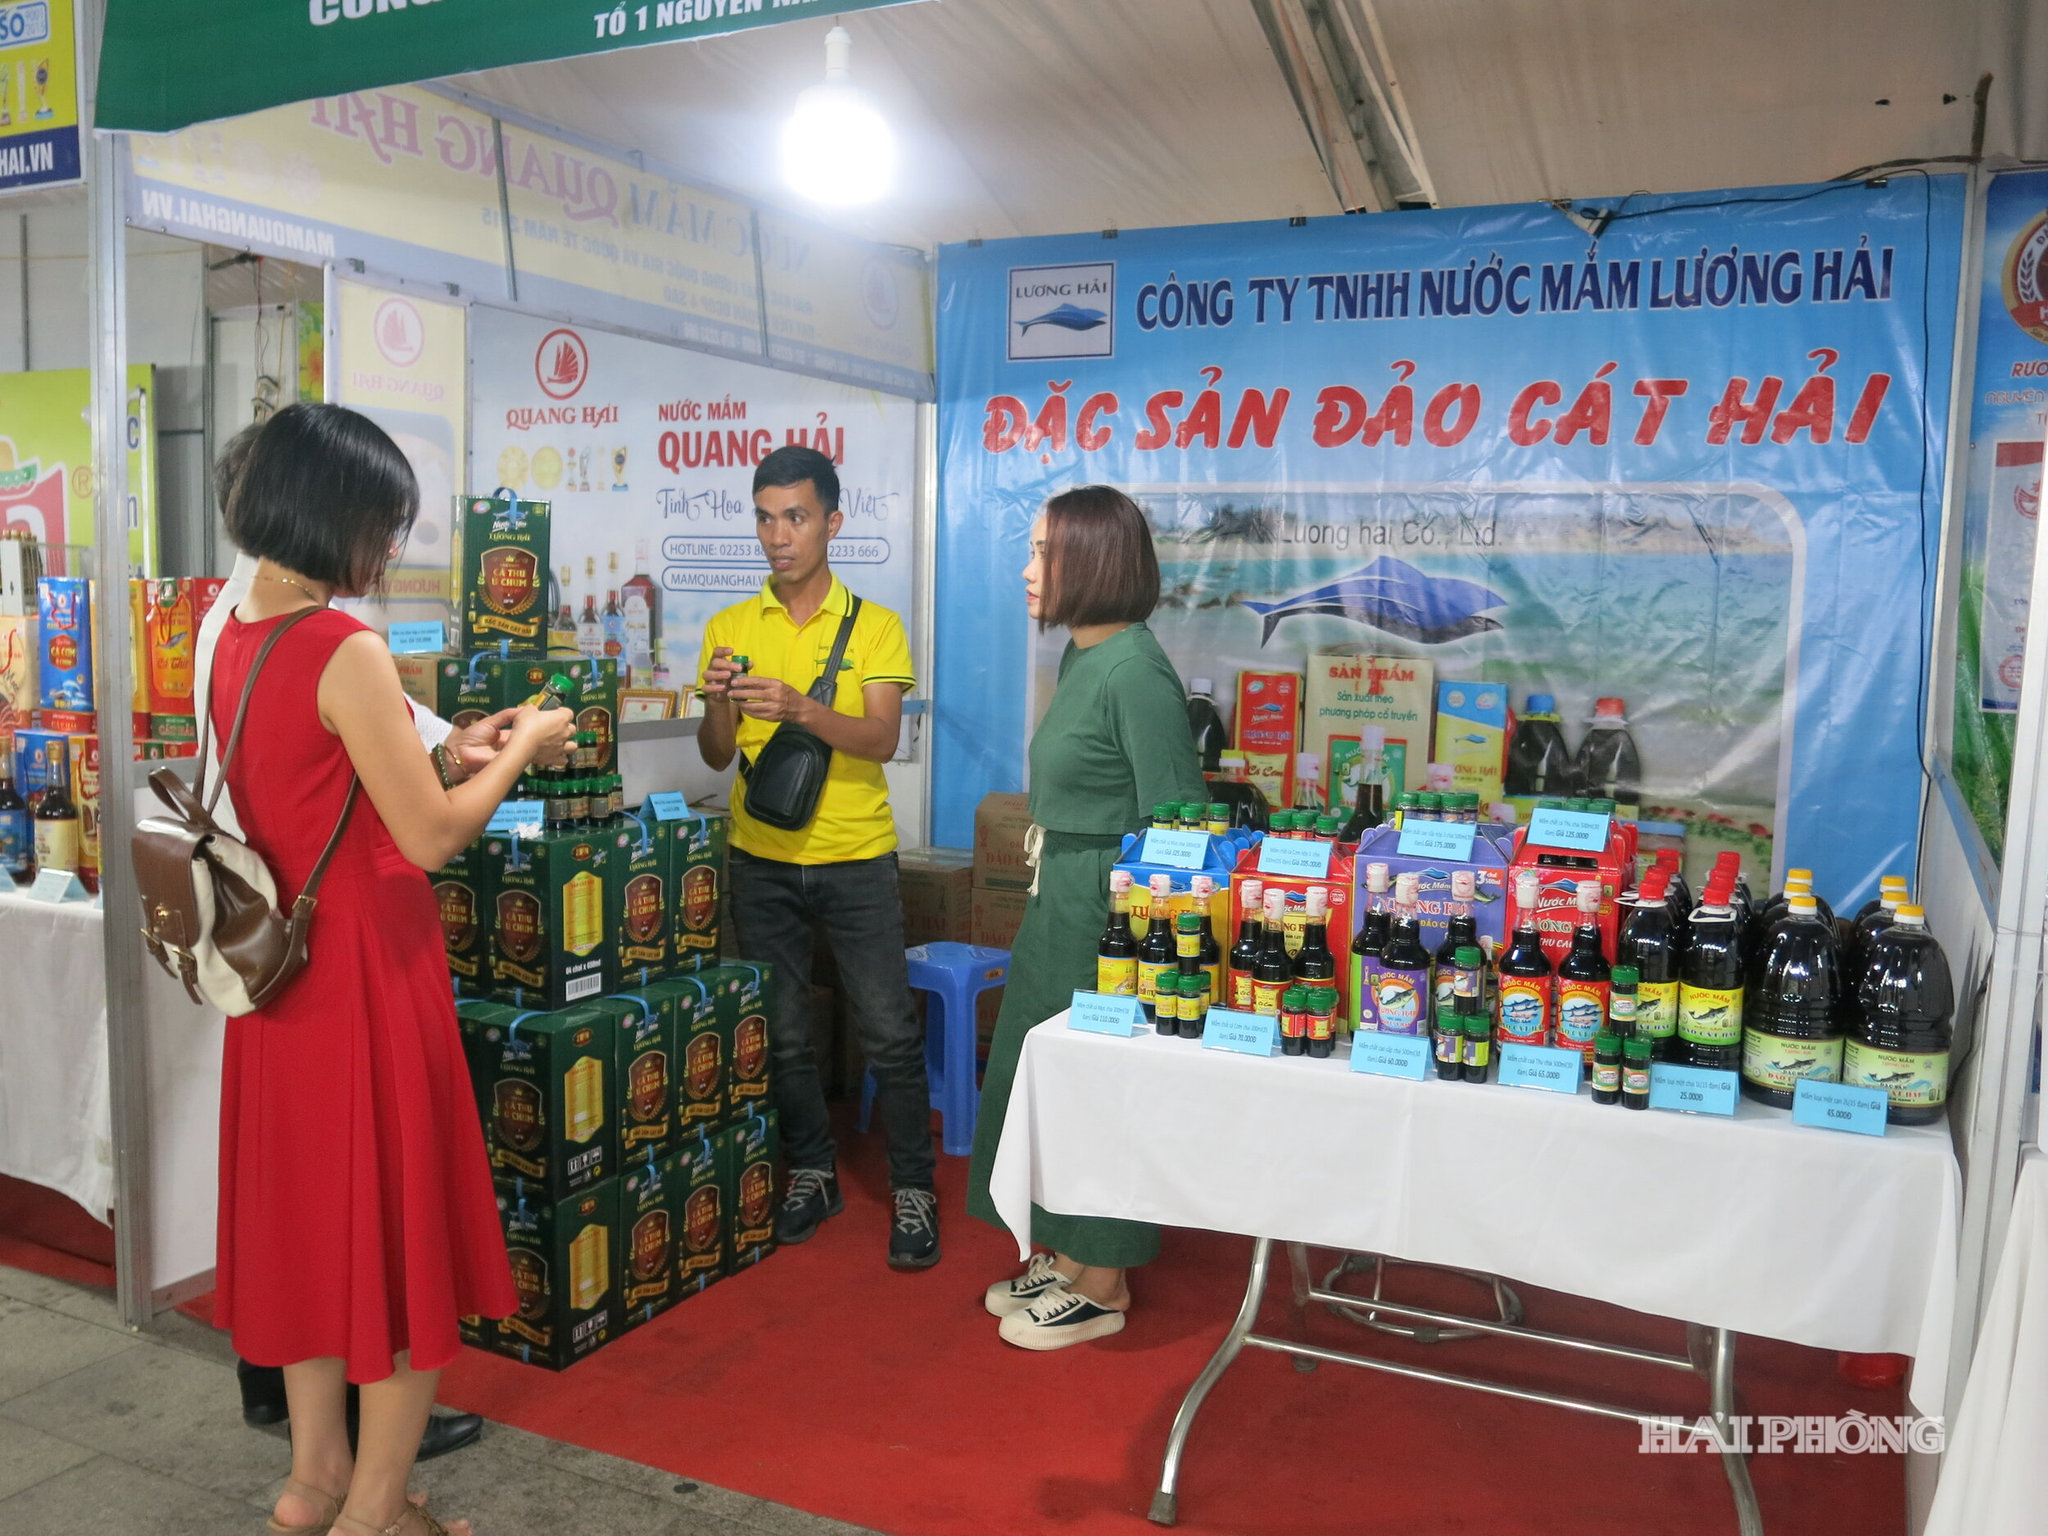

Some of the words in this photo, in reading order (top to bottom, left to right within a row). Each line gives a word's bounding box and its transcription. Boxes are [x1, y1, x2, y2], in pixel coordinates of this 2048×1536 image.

[635, 6, 647, 31] 1
[1015, 281, 1071, 299] LƯƠNG
[1076, 277, 1108, 296] HẢI
[1136, 271, 1234, 332] CÔNG
[1248, 275, 1300, 325] TY
[1306, 270, 1410, 322] TNHH
[1419, 251, 1531, 318] NƯỚC
[1538, 240, 1640, 313] MẮM
[1648, 245, 1802, 310] LƯƠNG
[1811, 235, 1894, 302] HẢI
[506, 406, 576, 431] QUANG
[658, 399, 702, 422] NƯỚC
[707, 394, 747, 421] MẮM
[982, 379, 1119, 466] ĐẶC
[1134, 365, 1290, 452] SẢN
[1312, 360, 1482, 450] ĐẢO
[1507, 361, 1689, 448] CÁT
[1704, 347, 1892, 447] HẢI
[658, 429, 773, 475] QUANG
[670, 543, 717, 557] HOTLINE:
[720, 544, 752, 557] 02253
[859, 545, 879, 558] 666
[1475, 870, 1487, 885] 3
